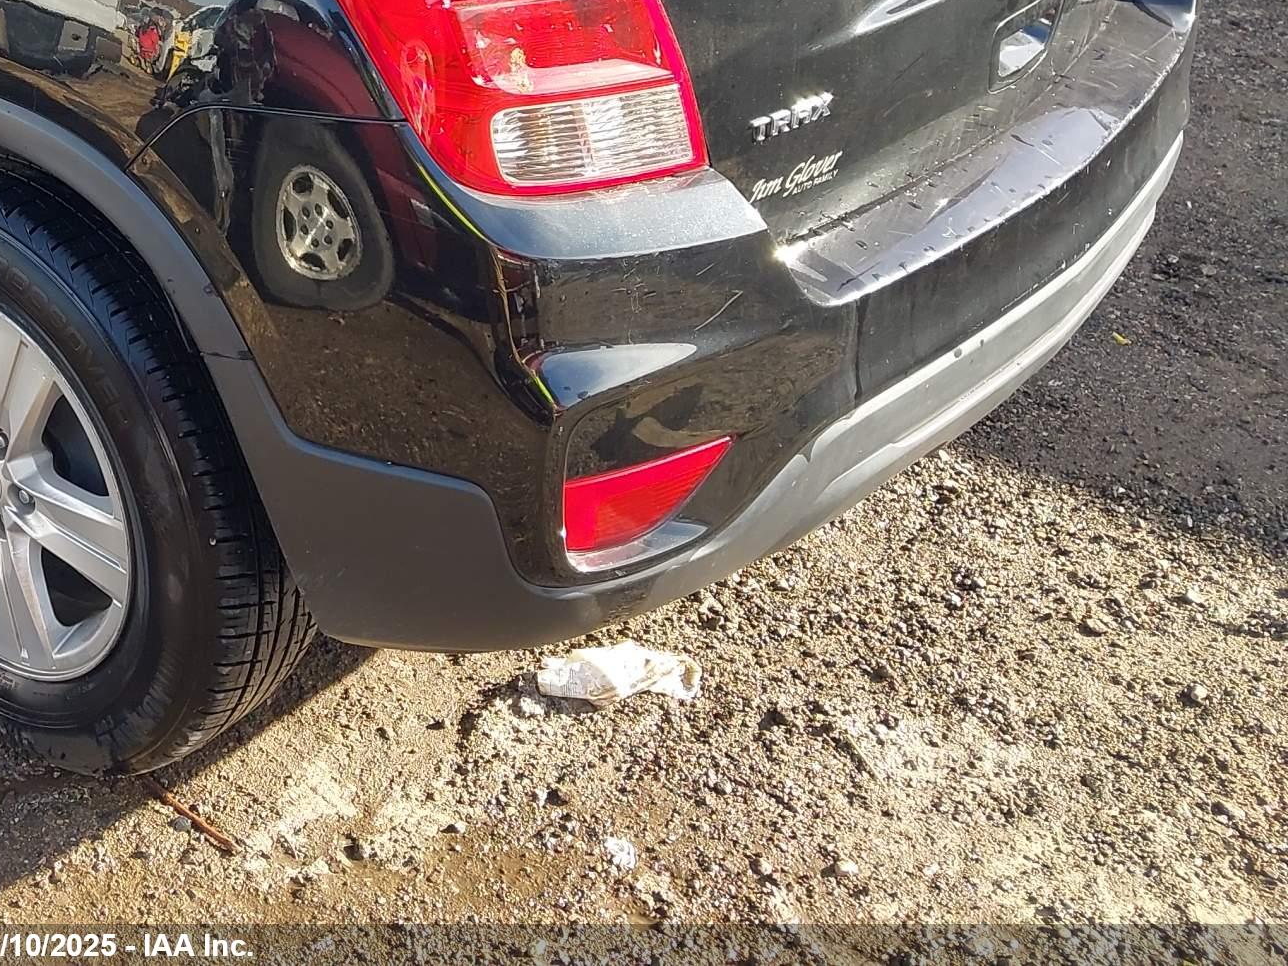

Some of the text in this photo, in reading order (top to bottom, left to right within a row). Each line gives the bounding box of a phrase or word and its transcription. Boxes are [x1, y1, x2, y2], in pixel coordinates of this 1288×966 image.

[749, 91, 834, 142] TRAX
[749, 150, 843, 204] Jim Glover
